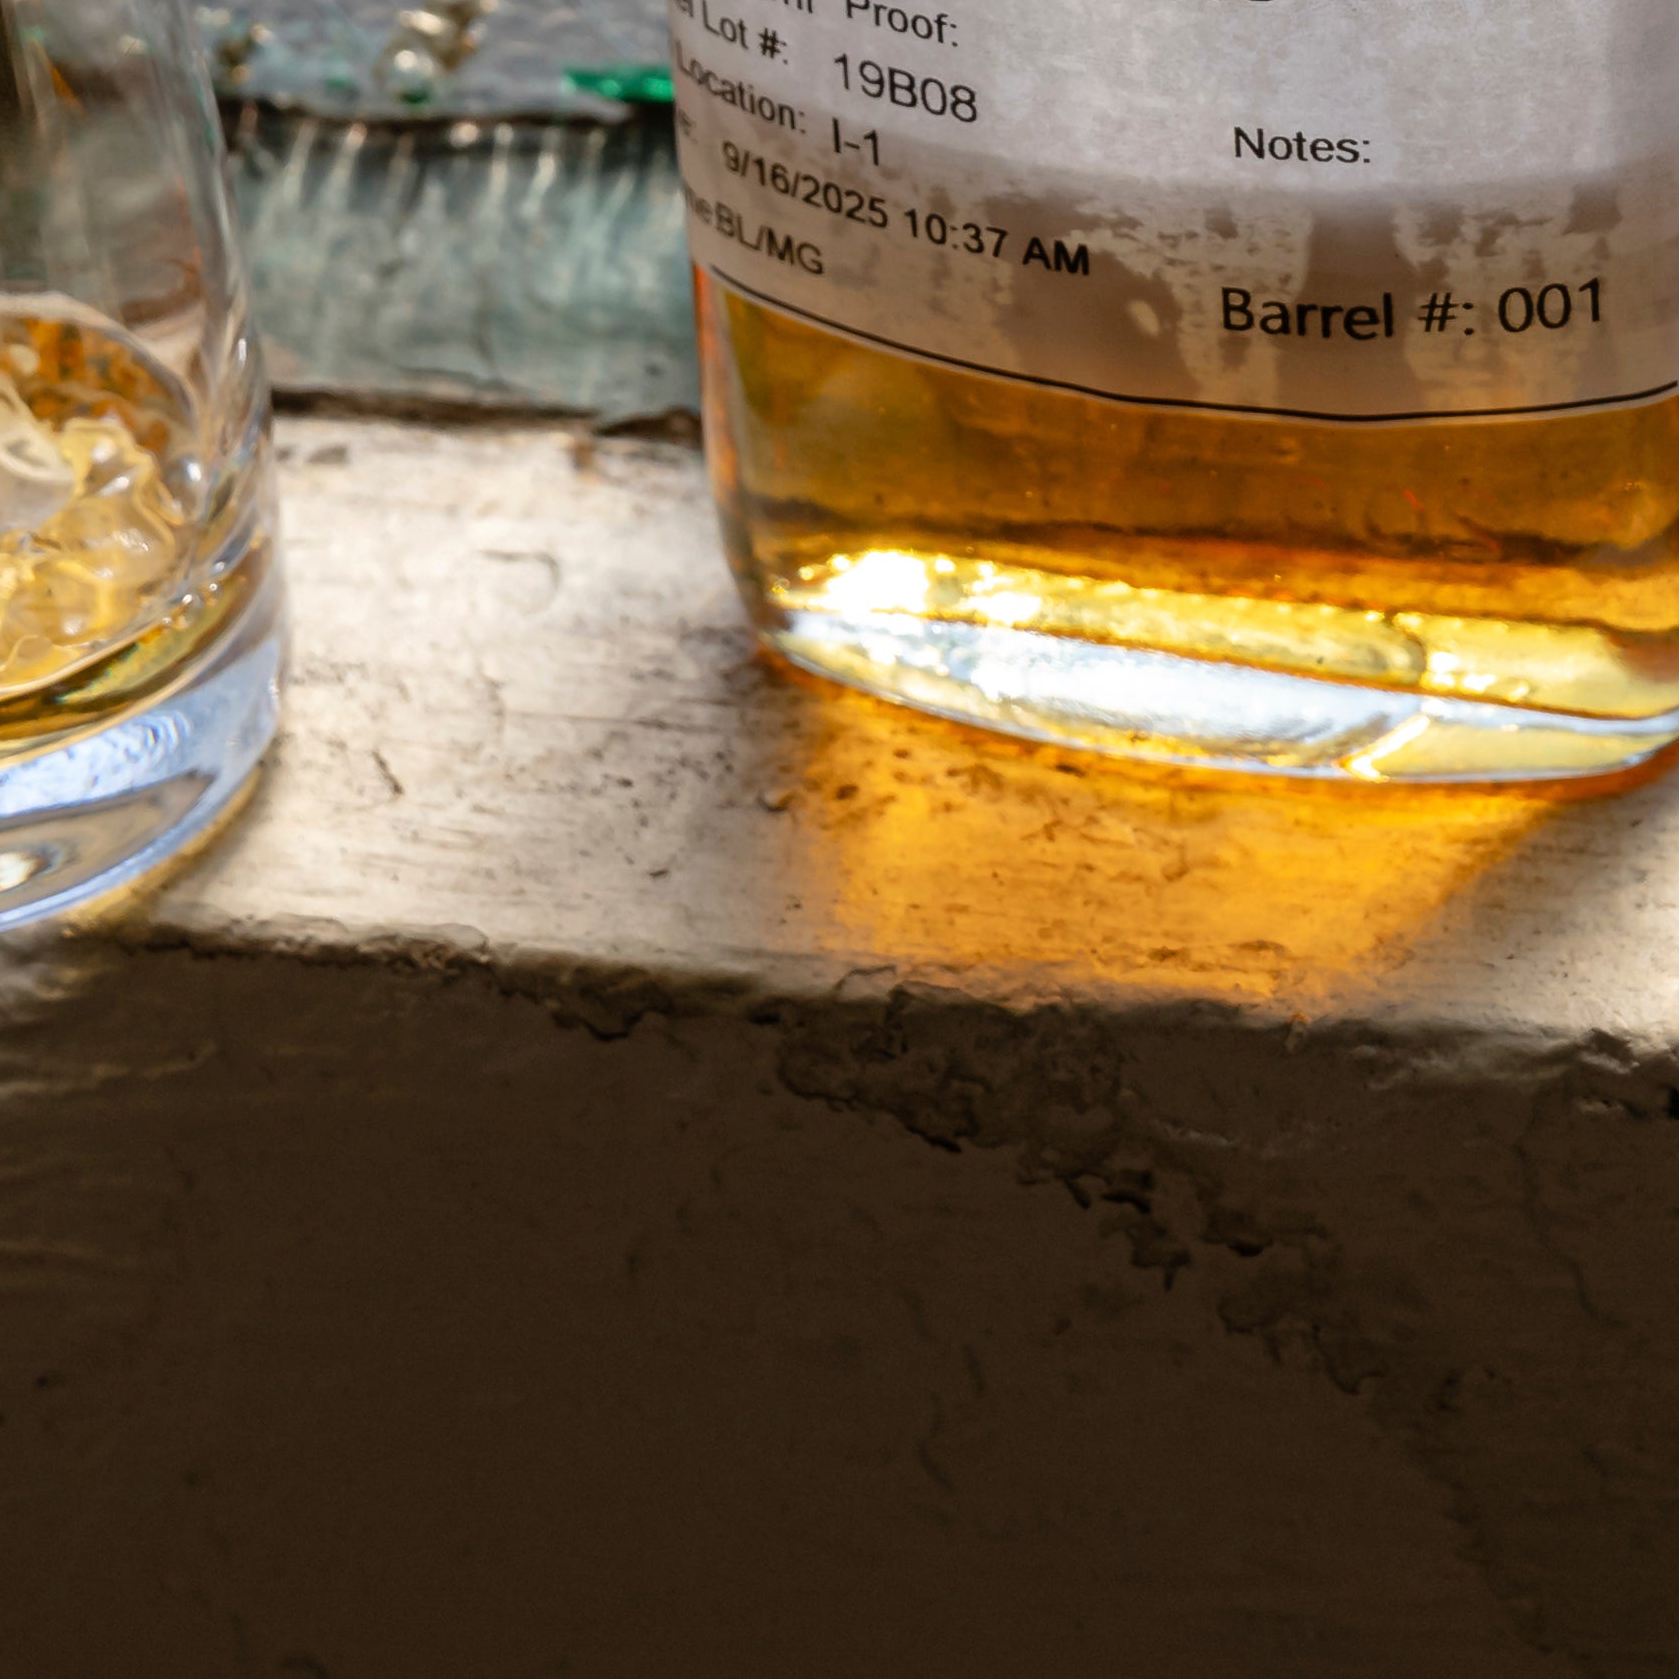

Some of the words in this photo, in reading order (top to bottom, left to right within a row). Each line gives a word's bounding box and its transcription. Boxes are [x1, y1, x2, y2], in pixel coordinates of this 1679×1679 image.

[676, 40, 806, 135] Location:
[759, 26, 788, 65] #:
[834, 53, 978, 123] 19B08
[1234, 127, 1371, 164] Notes:
[722, 140, 888, 228] 9/16/2025
[903, 208, 1009, 258] 10:37
[1022, 236, 1089, 276] AM
[1221, 286, 1394, 341] Barrel
[1418, 291, 1475, 336] #:
[1498, 276, 1602, 333] 001
